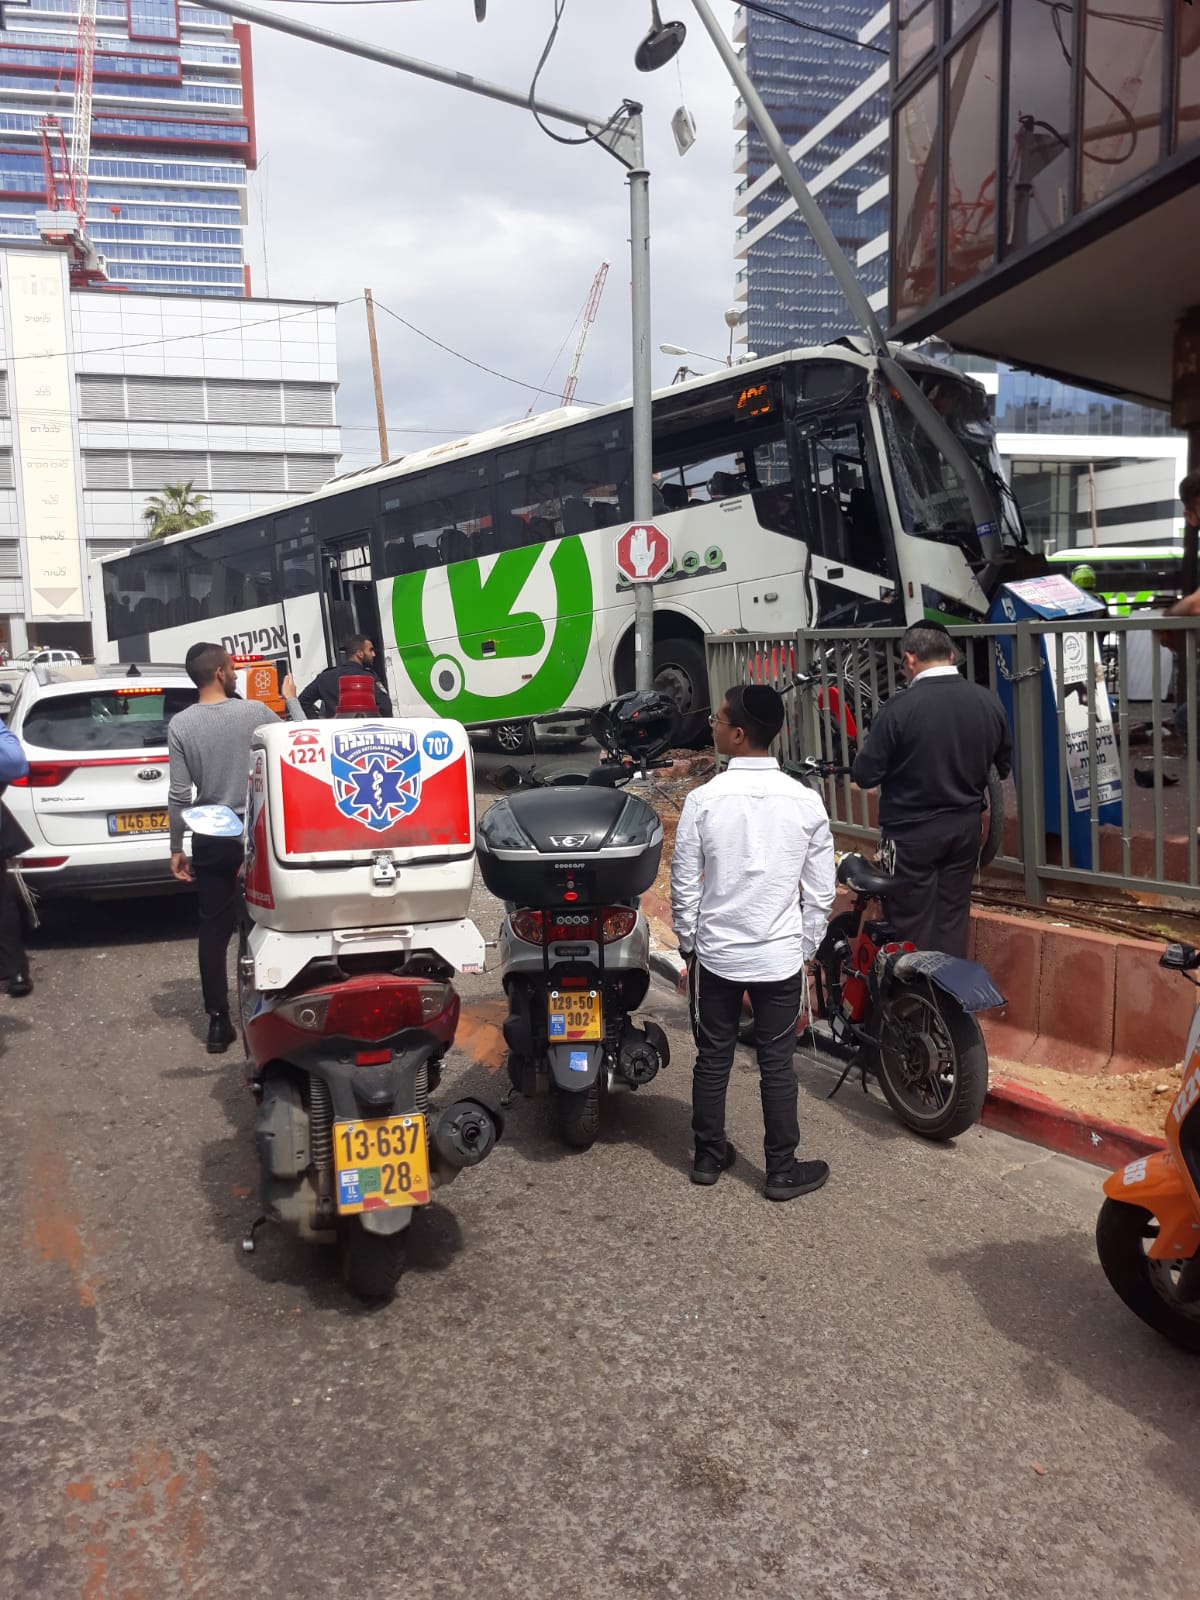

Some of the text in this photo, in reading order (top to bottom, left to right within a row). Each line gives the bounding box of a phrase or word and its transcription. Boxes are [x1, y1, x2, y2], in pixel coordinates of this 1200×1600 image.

[339, 732, 411, 757] איחוד הצלה
[426, 737, 450, 756] 707
[289, 747, 326, 765] 1221
[567, 1011, 590, 1027] 302
[341, 1123, 420, 1162] 13-637
[382, 1161, 412, 1195] 28
